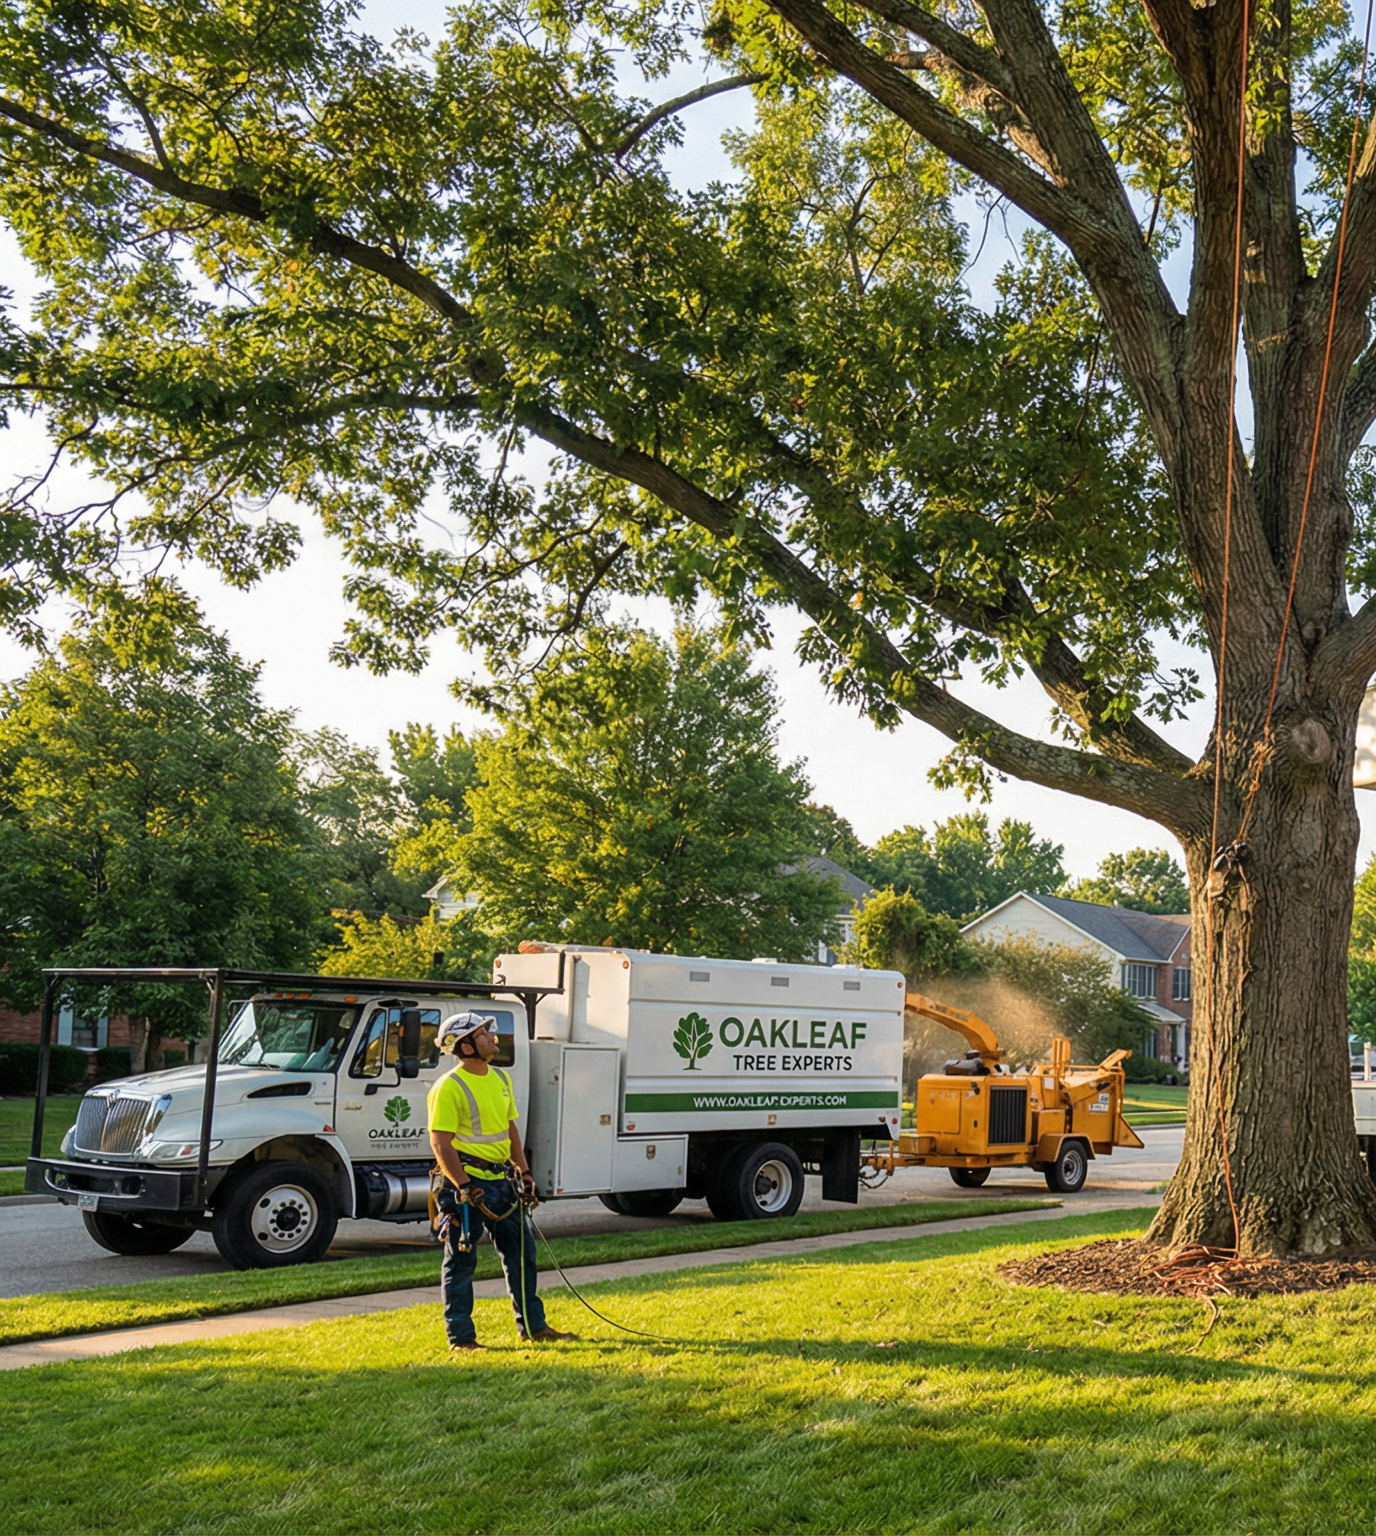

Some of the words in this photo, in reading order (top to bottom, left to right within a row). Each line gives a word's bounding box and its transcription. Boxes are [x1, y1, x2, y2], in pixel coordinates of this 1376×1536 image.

[719, 1017, 867, 1049] OAKLEAF
[733, 1055, 776, 1071] TREE
[782, 1055, 853, 1071] EXPERTS
